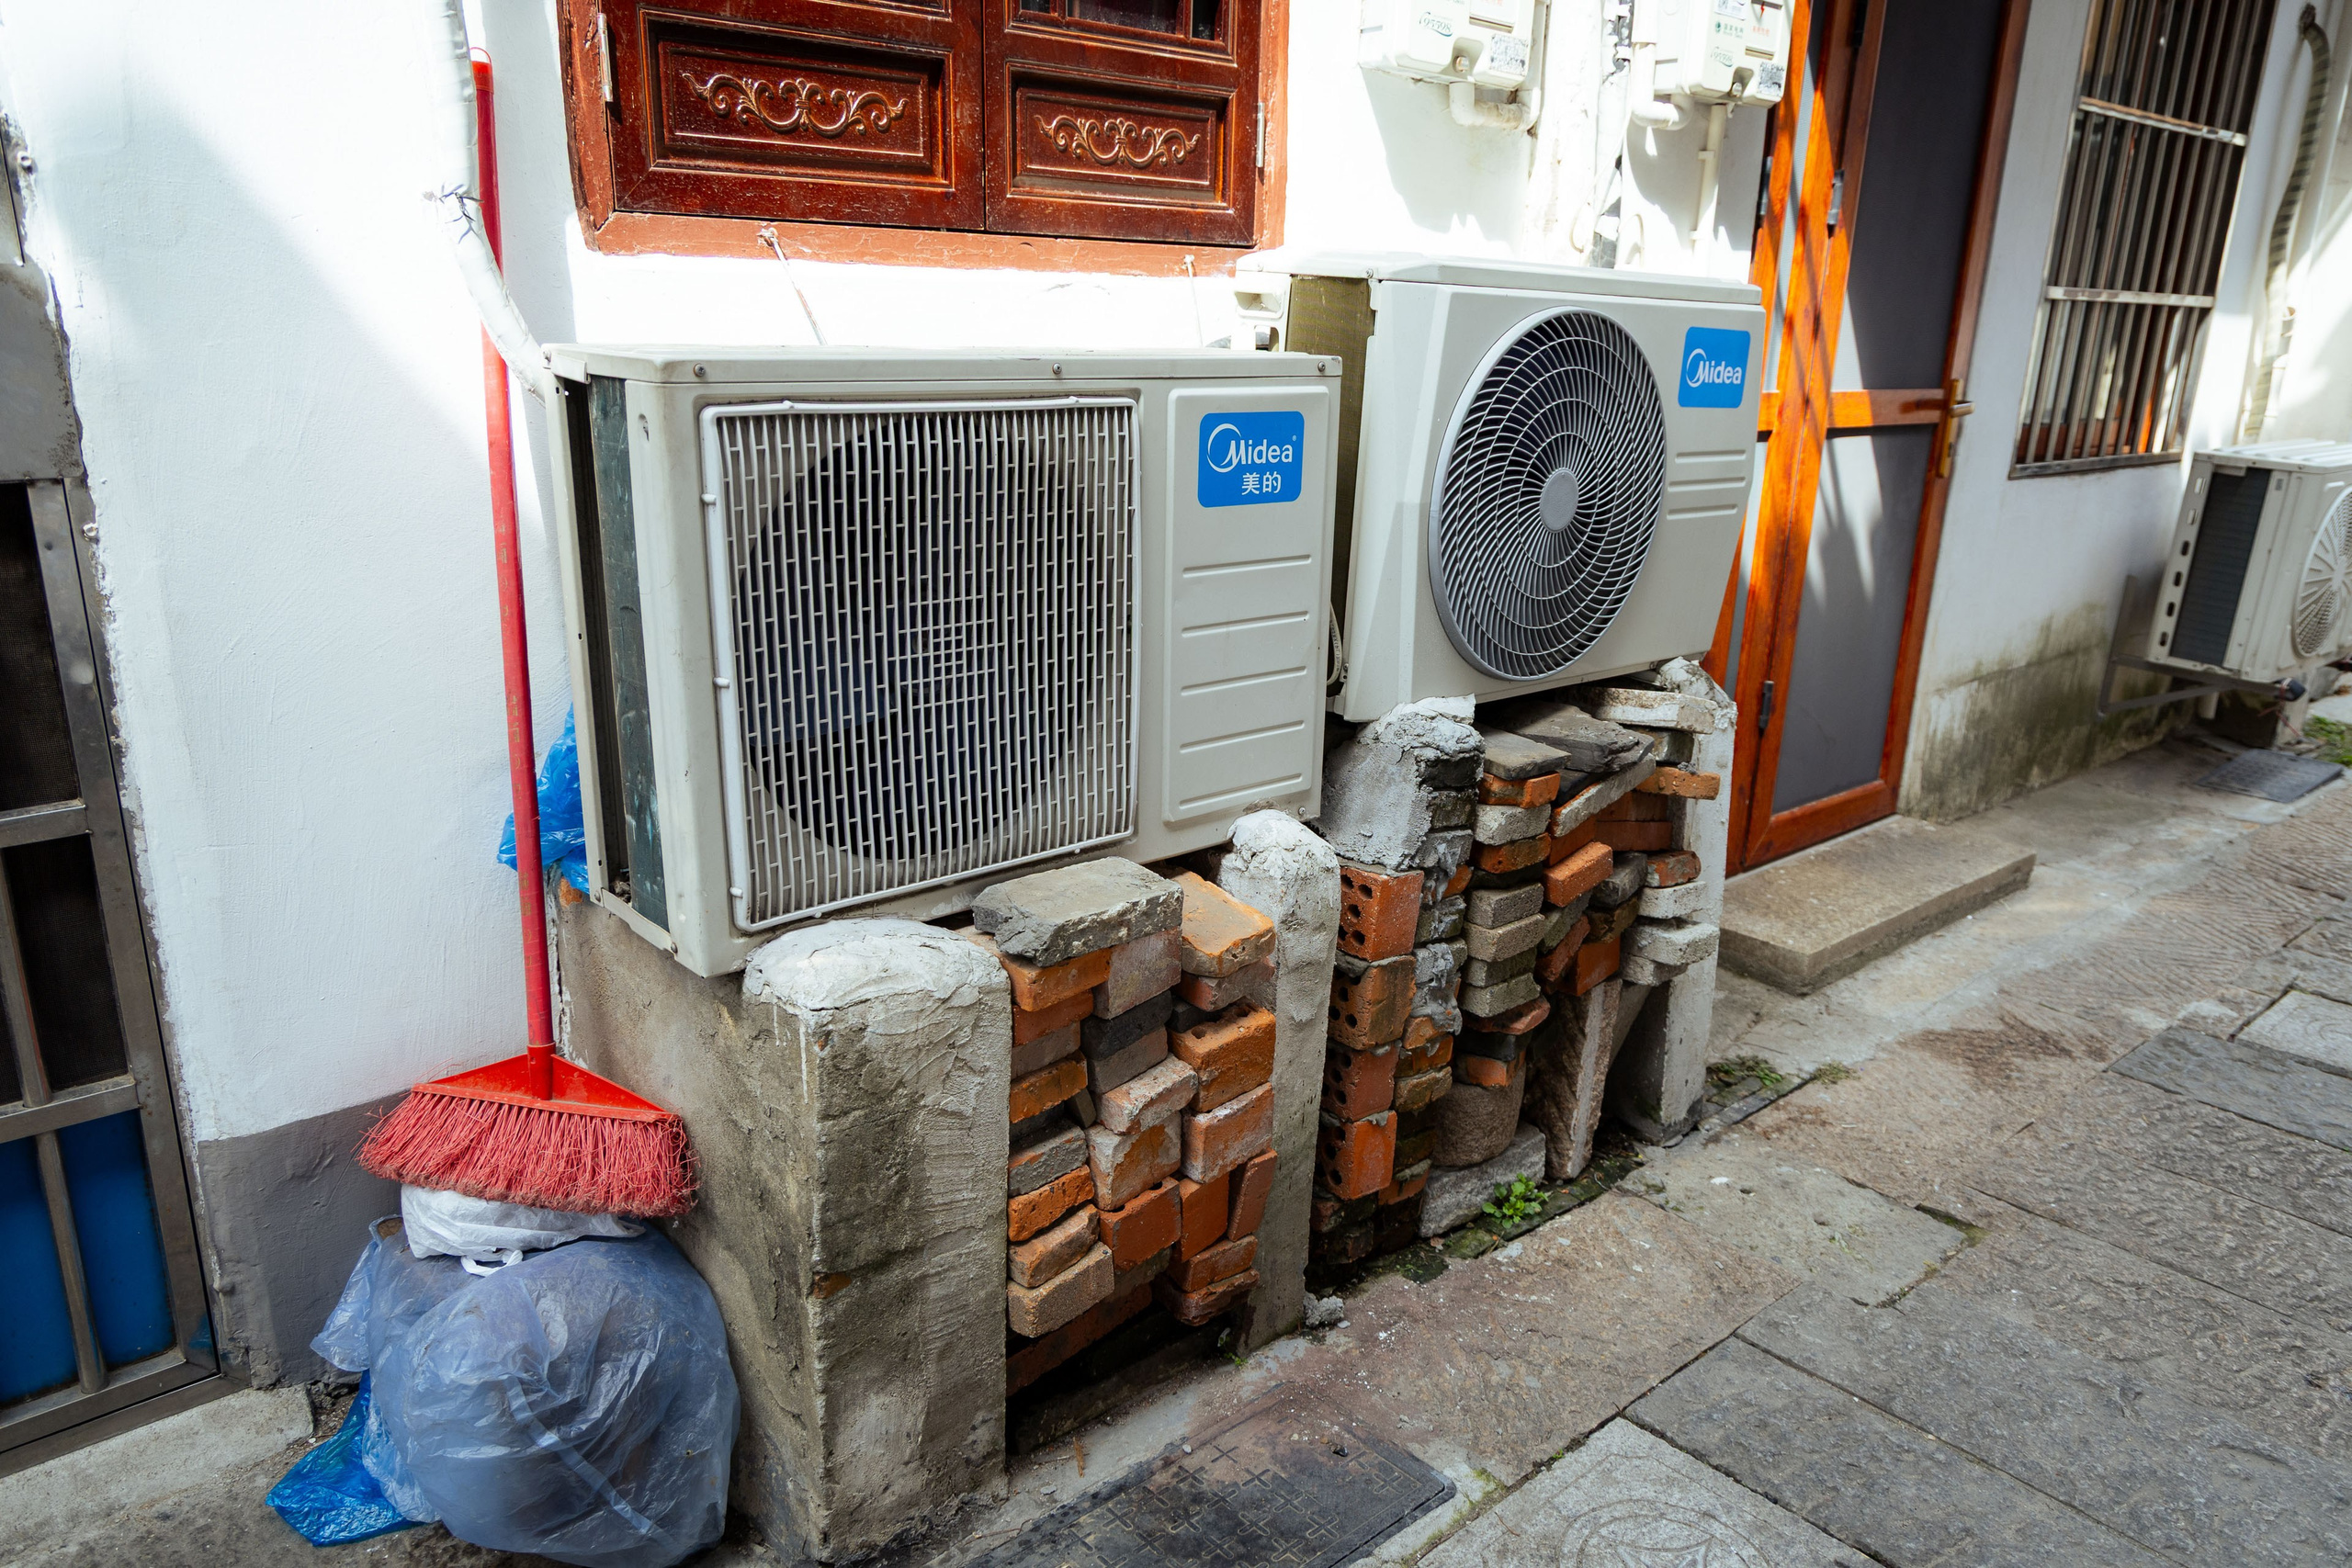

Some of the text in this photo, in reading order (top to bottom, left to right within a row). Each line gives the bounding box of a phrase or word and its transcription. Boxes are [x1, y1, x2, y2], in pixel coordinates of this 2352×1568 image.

[1686, 348, 1742, 388] Midea
[1206, 423, 1294, 473] Midea
[1241, 471, 1282, 495] 美的
